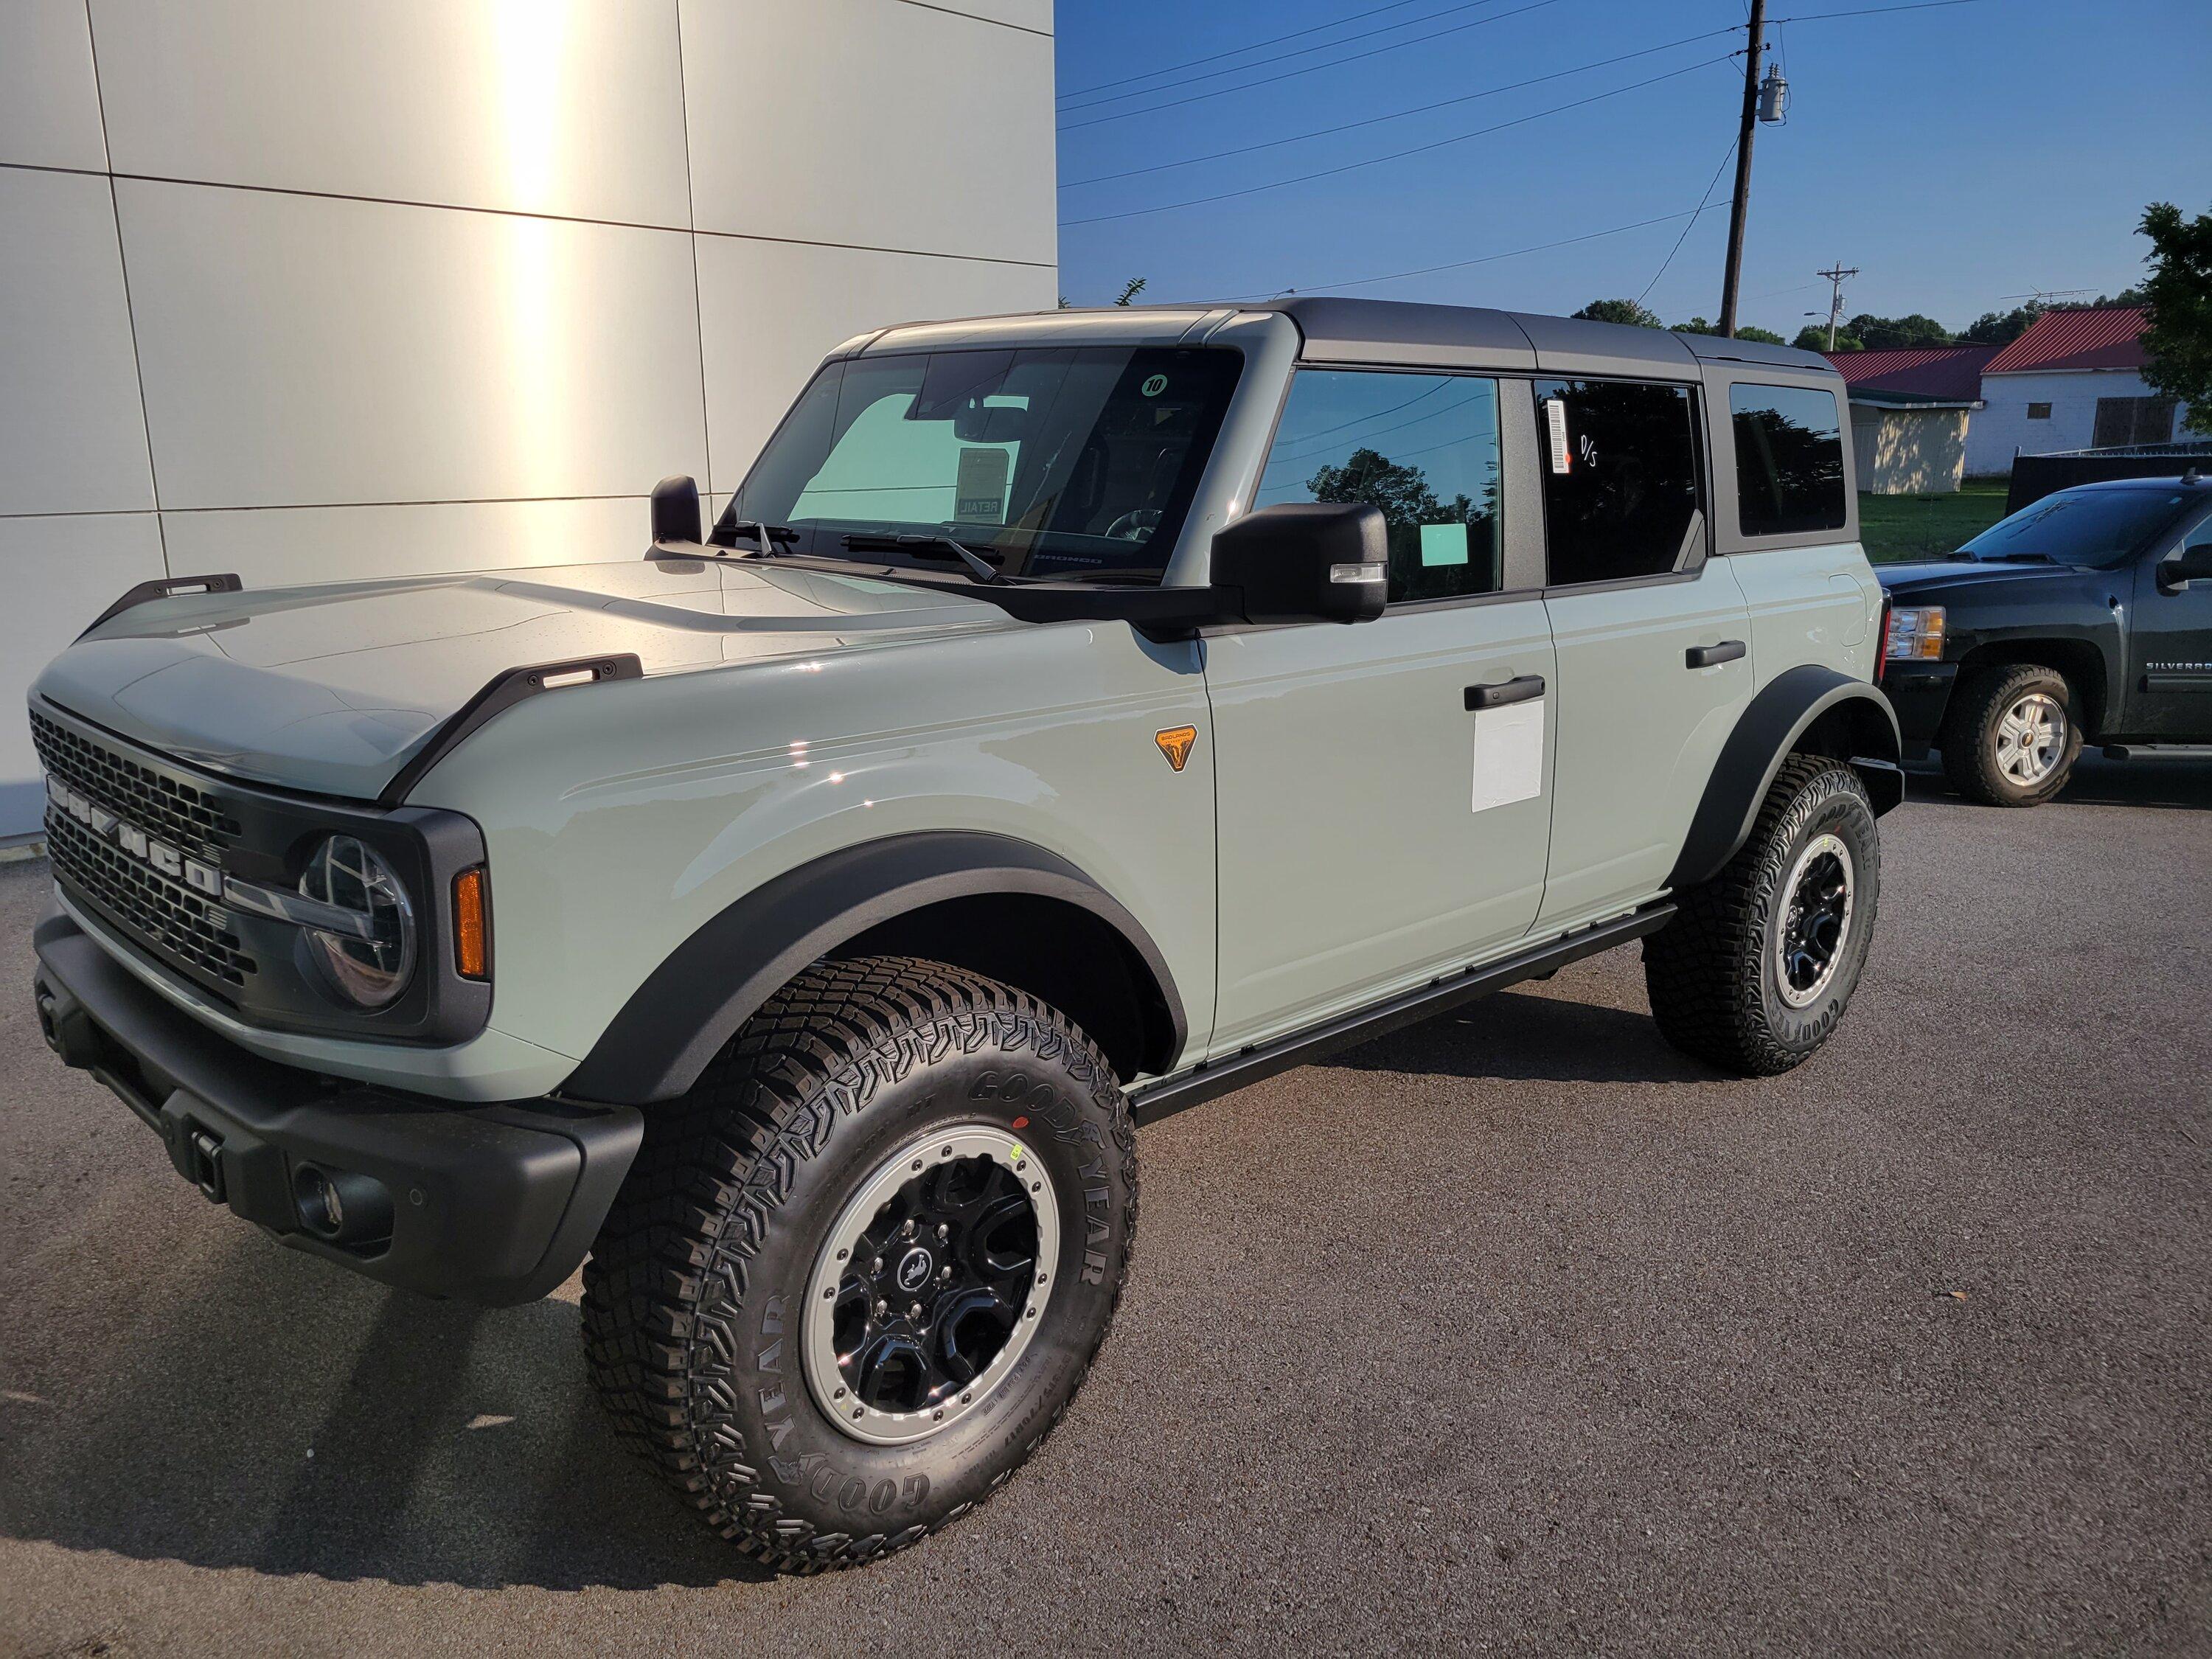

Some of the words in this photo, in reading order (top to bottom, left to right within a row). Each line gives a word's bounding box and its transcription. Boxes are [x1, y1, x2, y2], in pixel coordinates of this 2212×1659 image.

[1146, 378, 1164, 392] 10
[968, 1071, 1110, 1287] GOODYEAR
[757, 1295, 931, 1515] GOODYEAR
